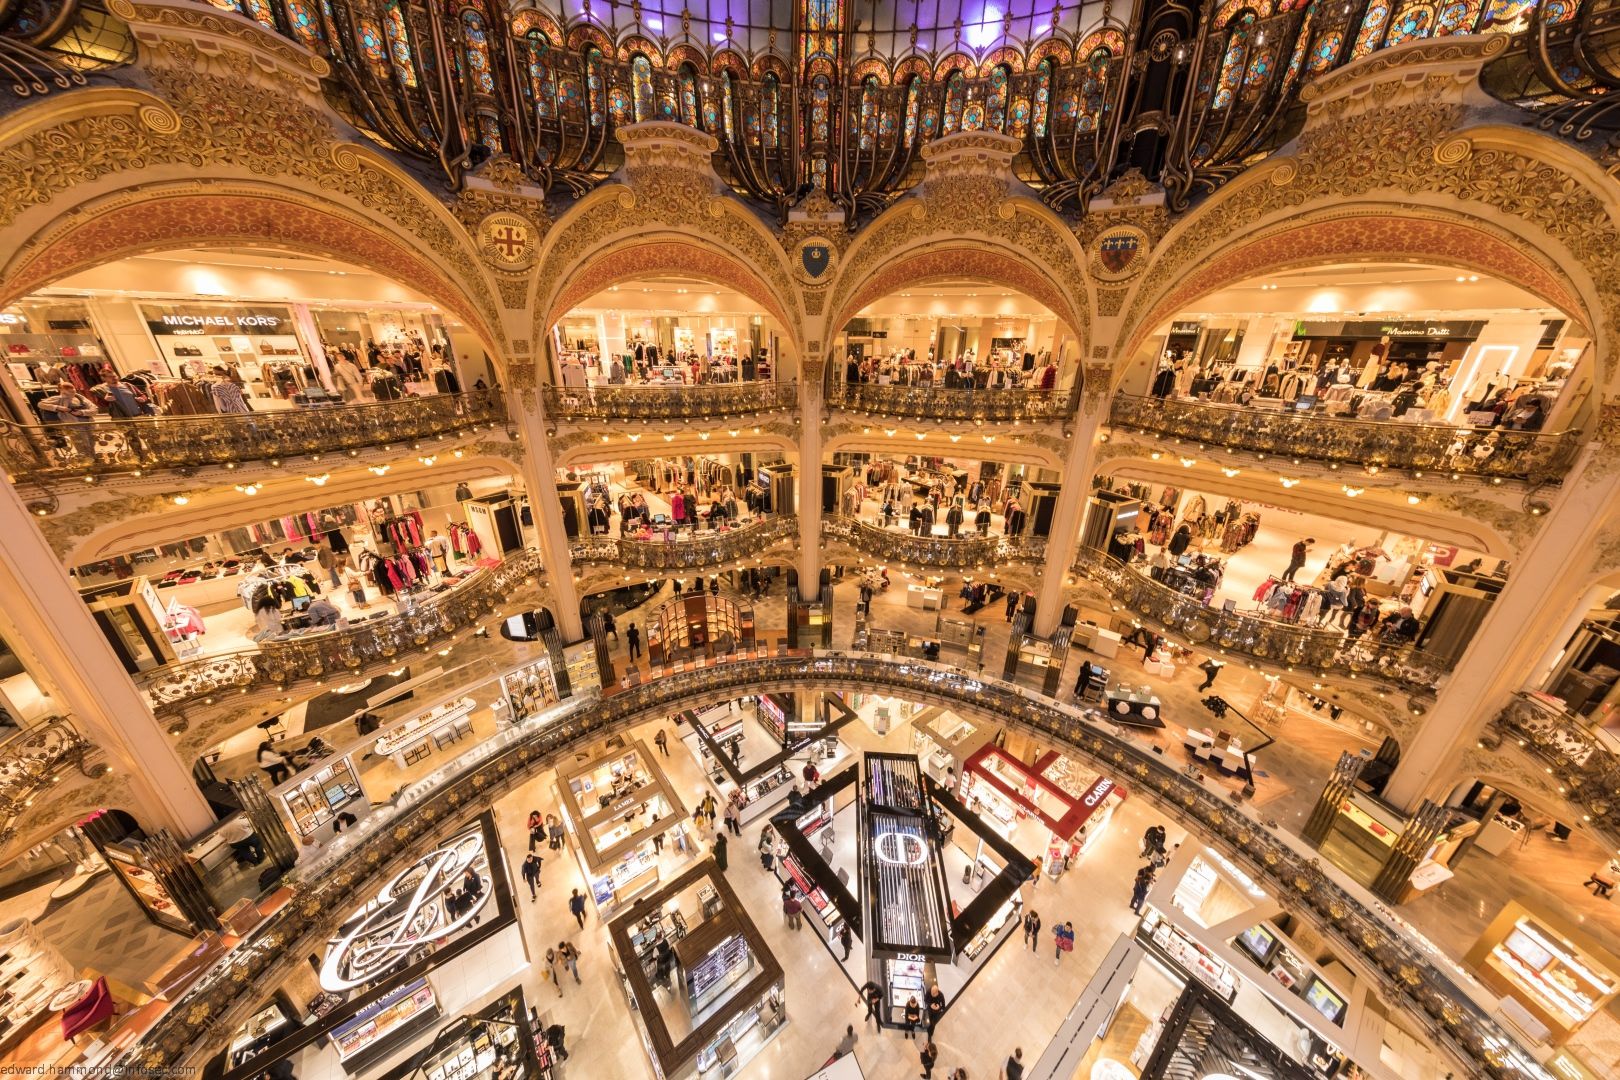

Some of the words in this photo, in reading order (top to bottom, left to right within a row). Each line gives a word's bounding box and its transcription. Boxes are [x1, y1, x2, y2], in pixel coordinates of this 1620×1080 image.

[162, 315, 234, 326] MICHAEL
[236, 316, 278, 326] KORS
[1387, 327, 1425, 335] Massimo
[1427, 327, 1450, 335] Dutti
[1085, 778, 1113, 806] CLARIN
[897, 952, 925, 962] DIOR
